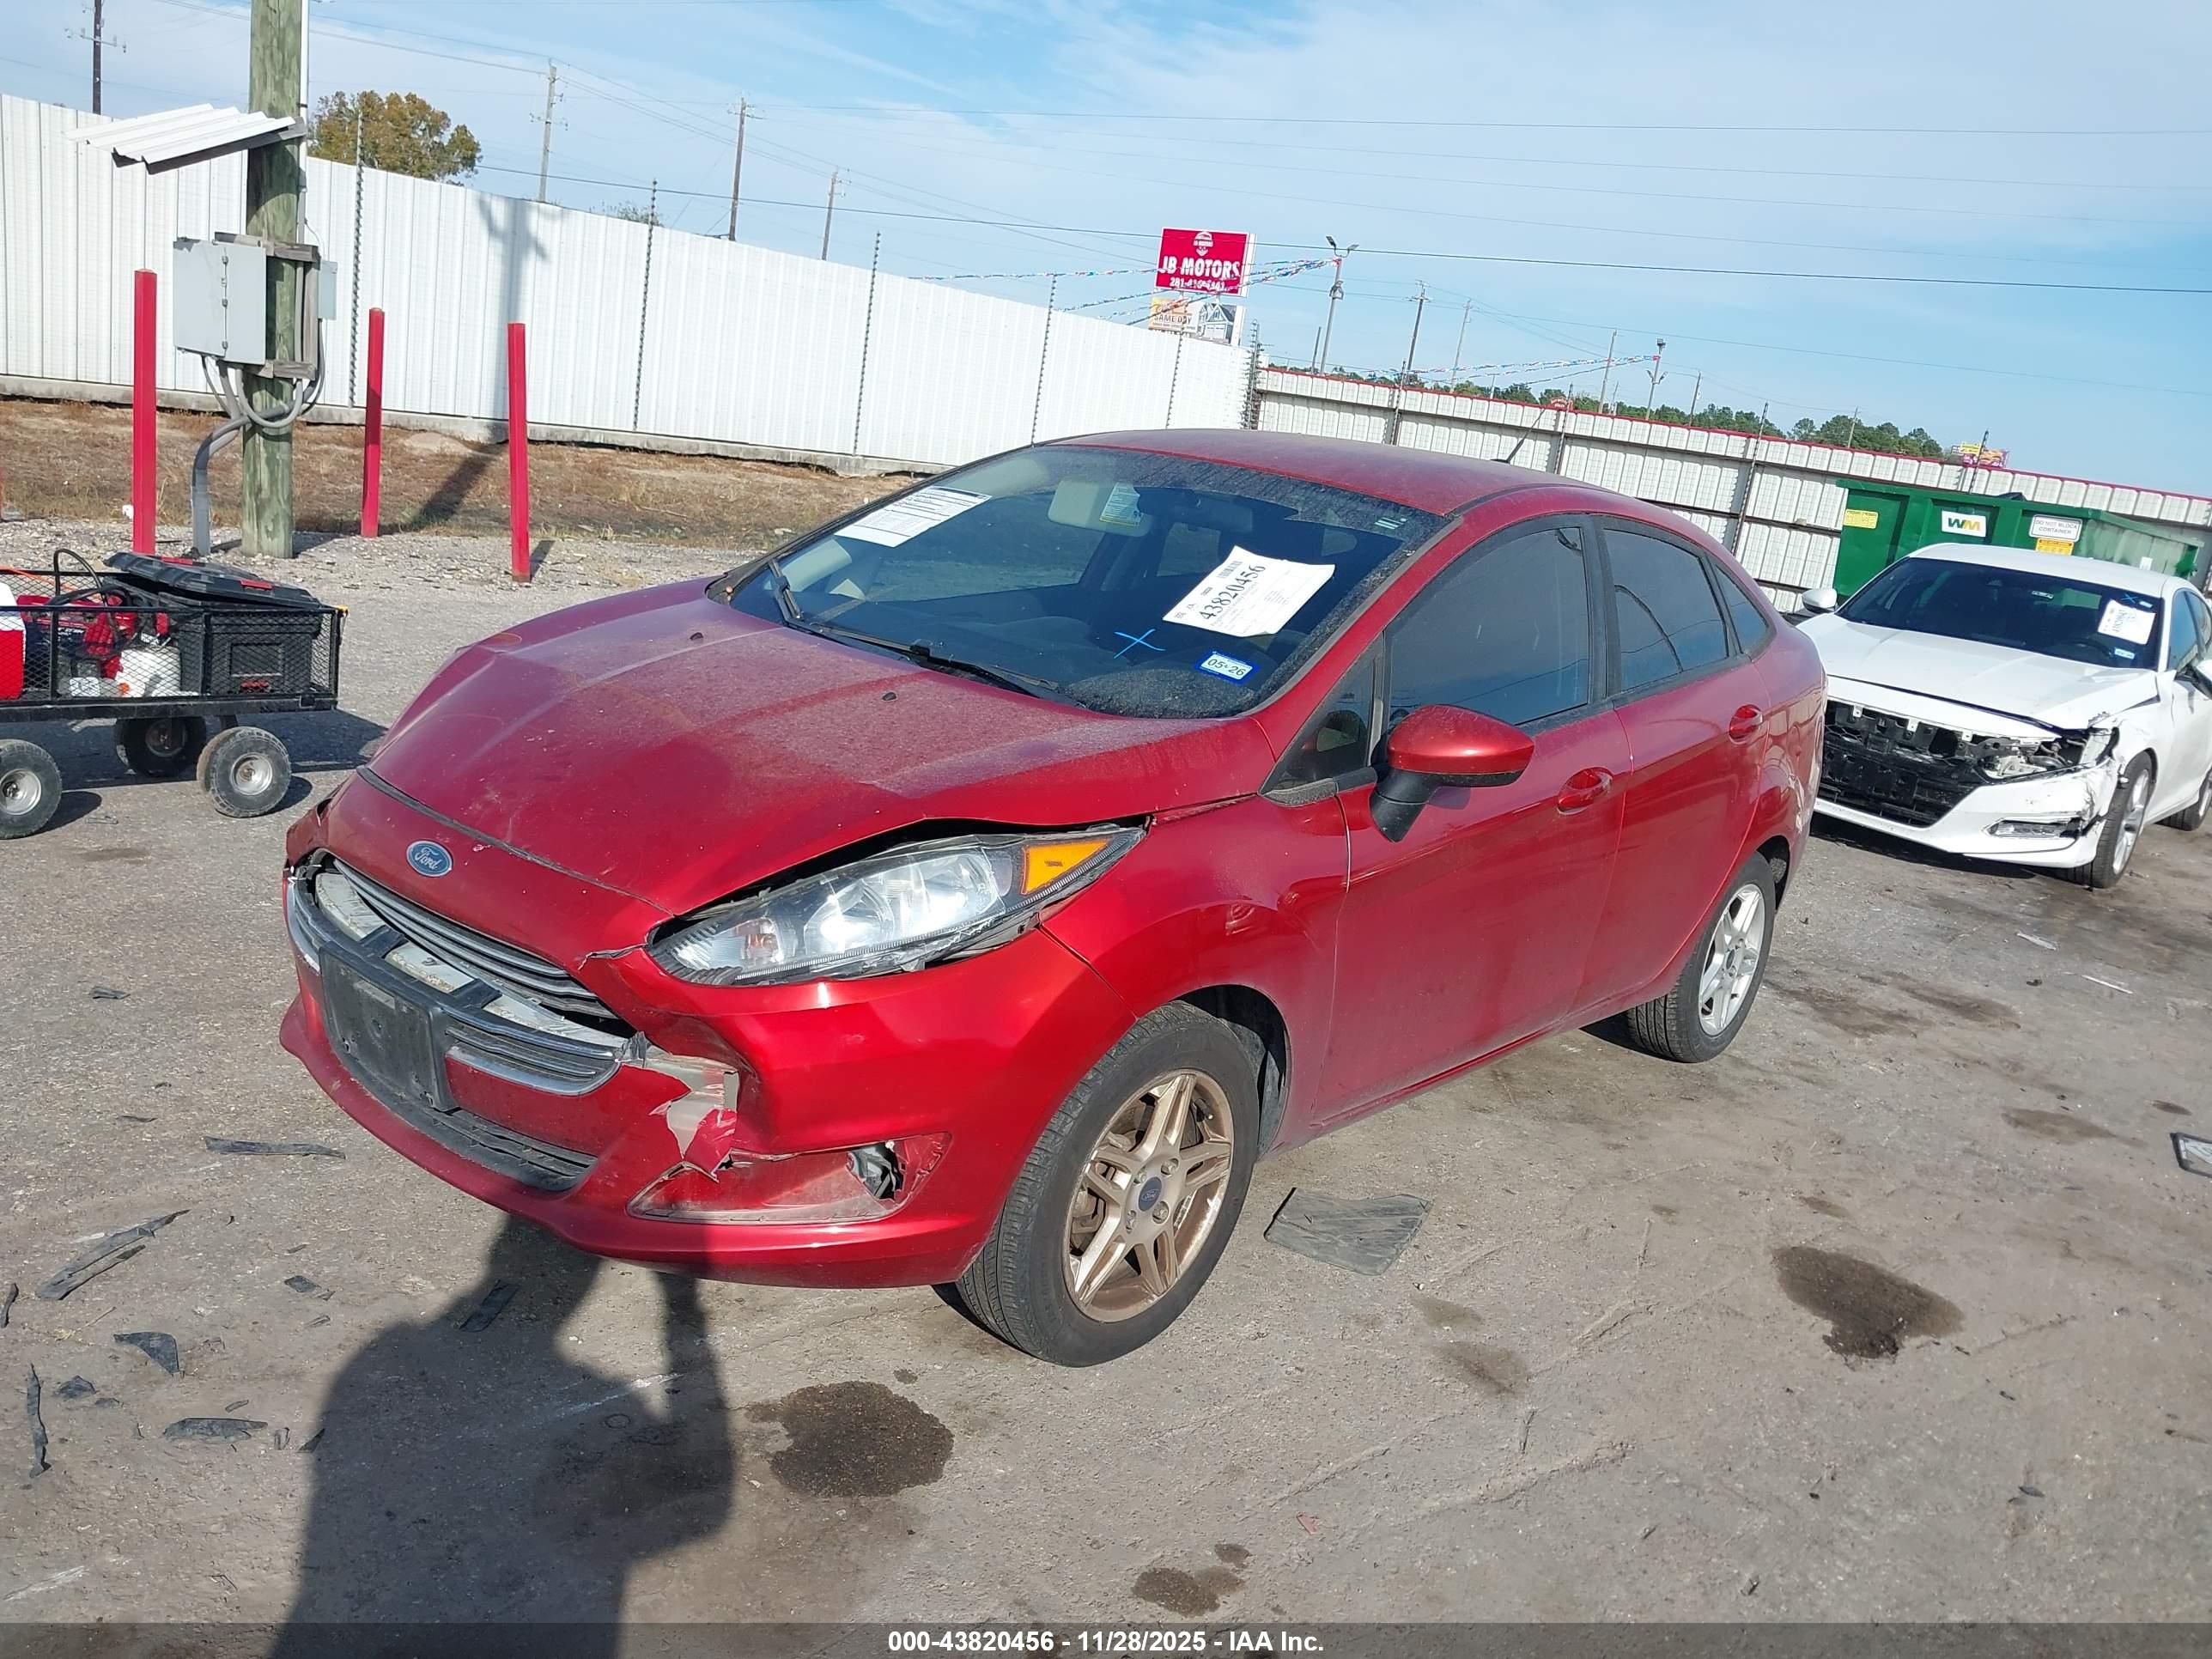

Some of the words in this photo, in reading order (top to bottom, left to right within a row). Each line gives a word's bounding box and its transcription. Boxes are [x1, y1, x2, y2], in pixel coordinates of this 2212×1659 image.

[1159, 255, 1177, 274] JB
[1180, 257, 1241, 279] MOTORS
[1948, 517, 1981, 532] WM
[1199, 564, 1267, 621] 43820456
[1207, 659, 1226, 669] 05
[1228, 665, 1247, 677] 26
[414, 847, 443, 870] Ford
